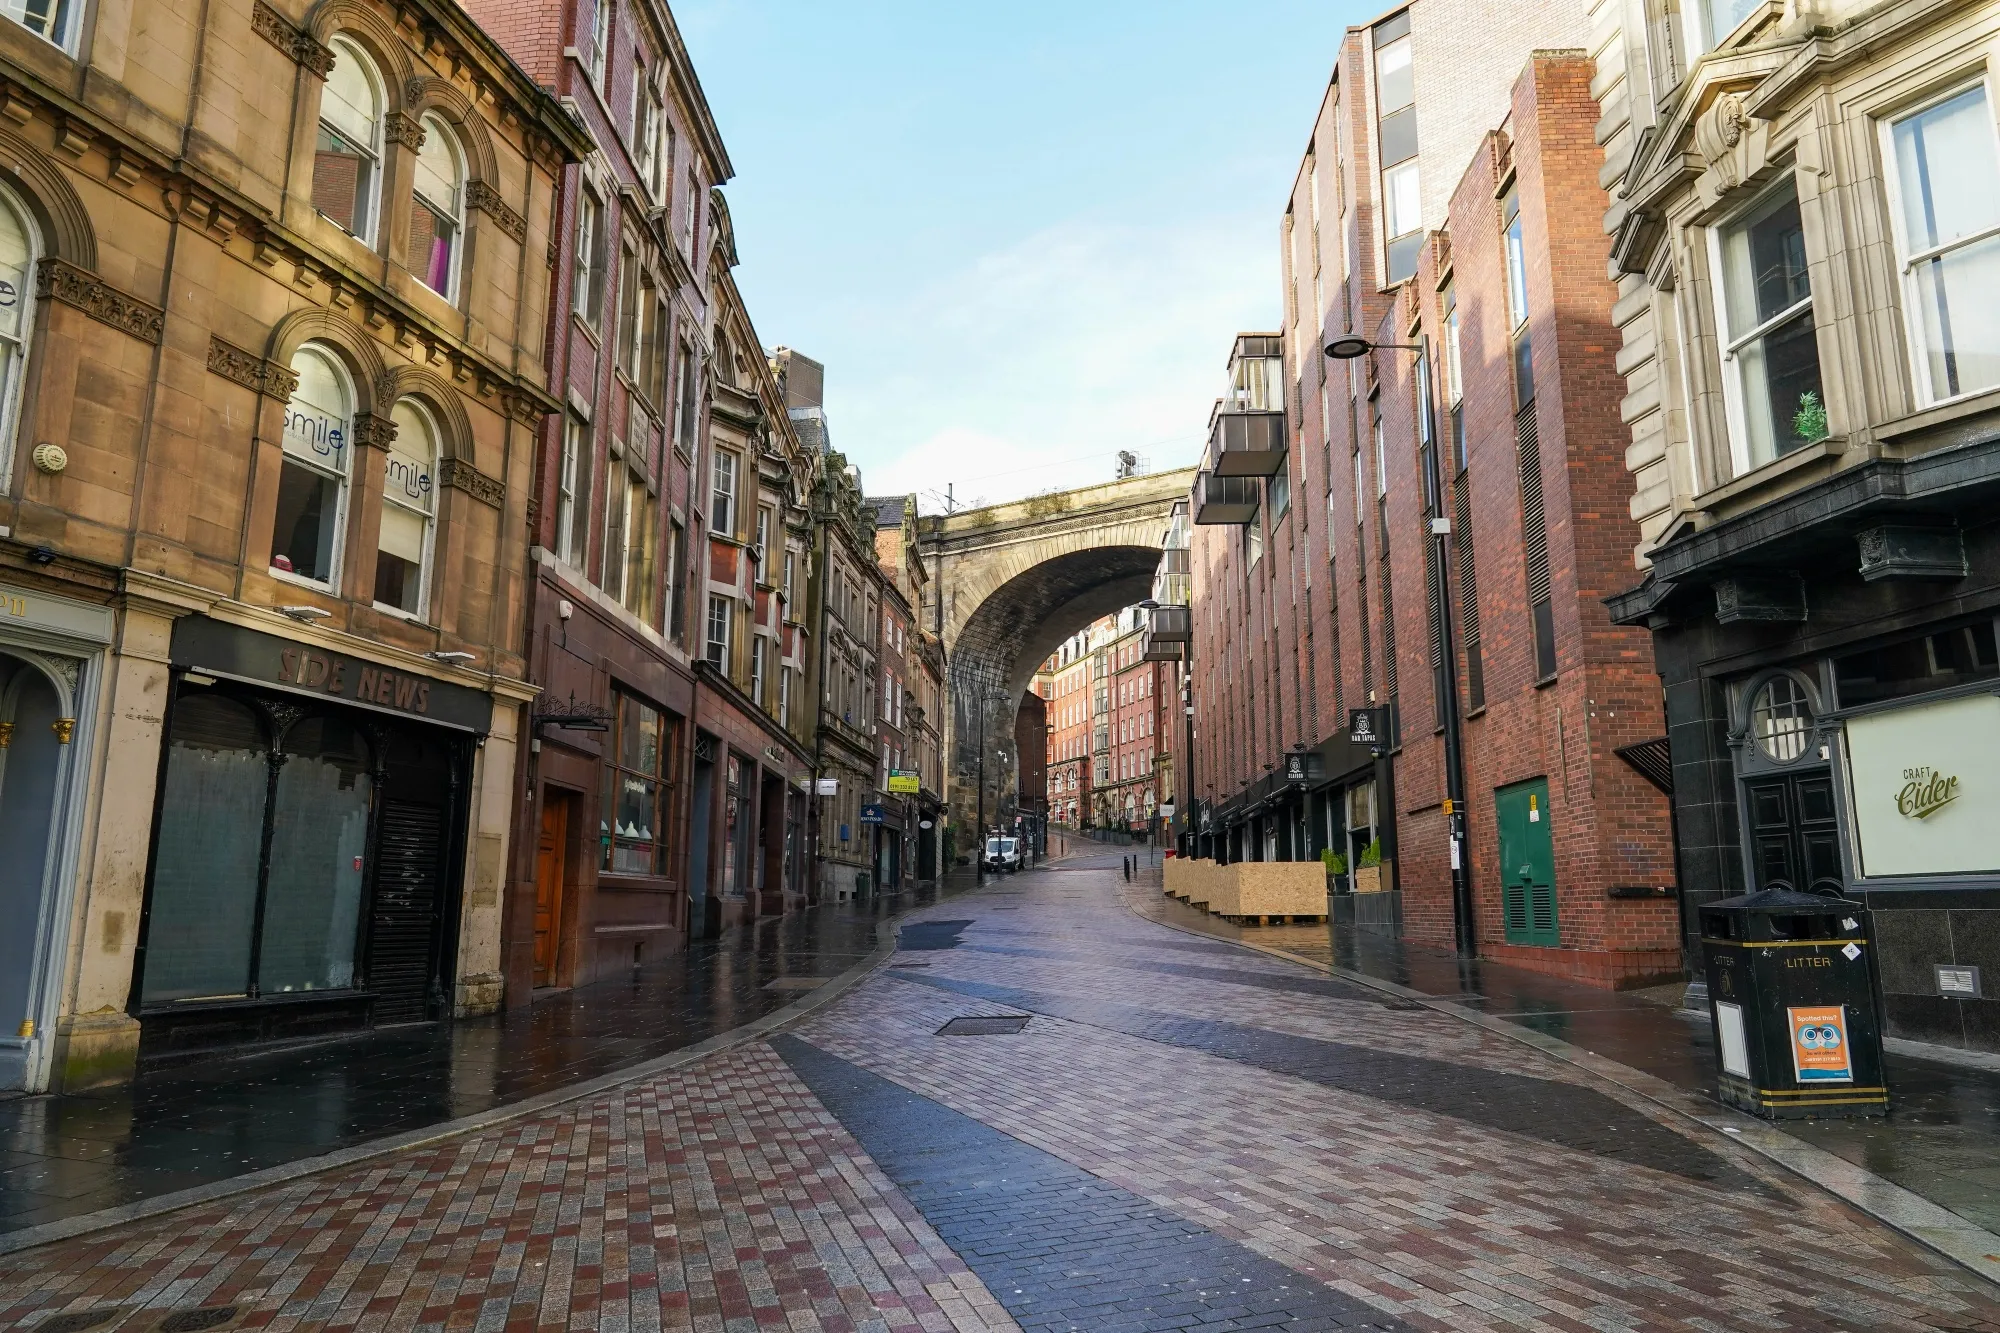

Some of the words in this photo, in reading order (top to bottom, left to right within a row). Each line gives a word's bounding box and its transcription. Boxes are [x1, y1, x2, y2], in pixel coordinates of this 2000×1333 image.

[278, 648, 346, 694] SIDE
[356, 667, 430, 713] NEWS
[1903, 766, 1931, 779] CRAFT
[1894, 771, 1959, 815] Cider
[1715, 955, 1734, 966] LITTER
[1786, 957, 1831, 968] LITTER
